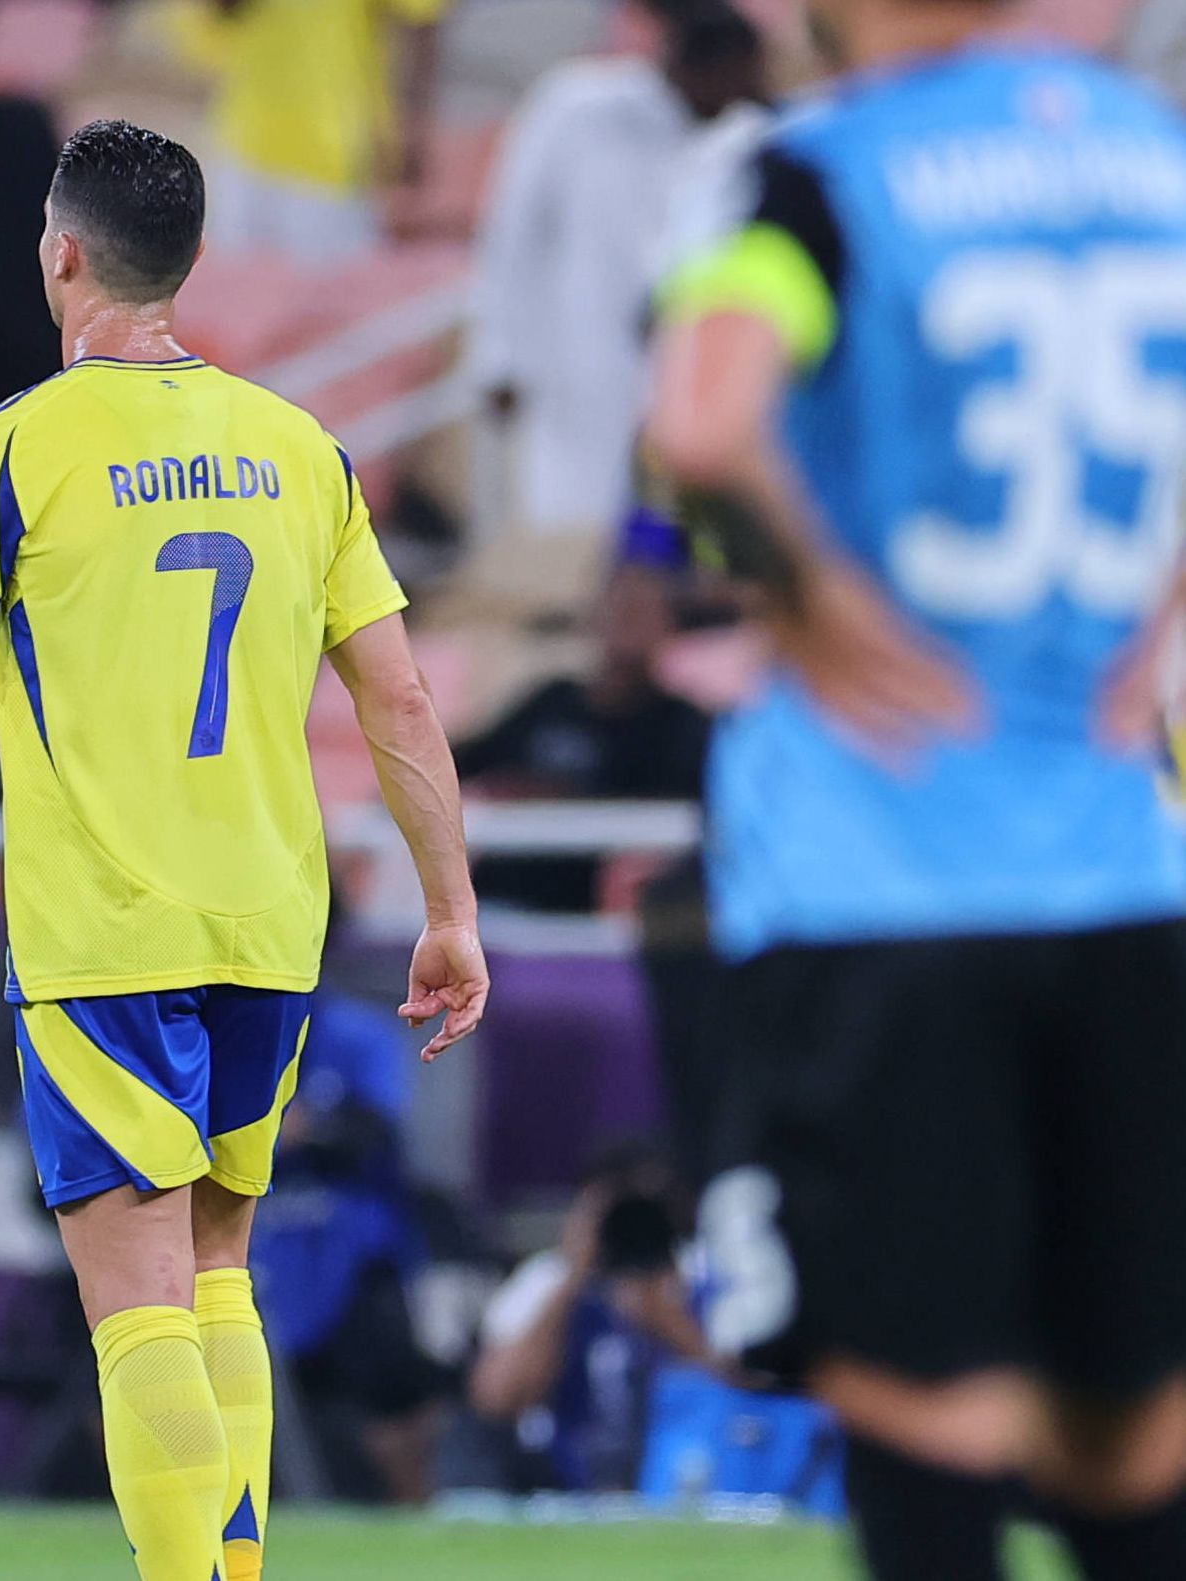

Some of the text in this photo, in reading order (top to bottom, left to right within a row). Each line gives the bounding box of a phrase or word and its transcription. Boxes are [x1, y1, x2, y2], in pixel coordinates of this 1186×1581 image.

[108, 454, 281, 508] RONALDO
[886, 243, 1185, 622] 35
[155, 531, 254, 759] 7
